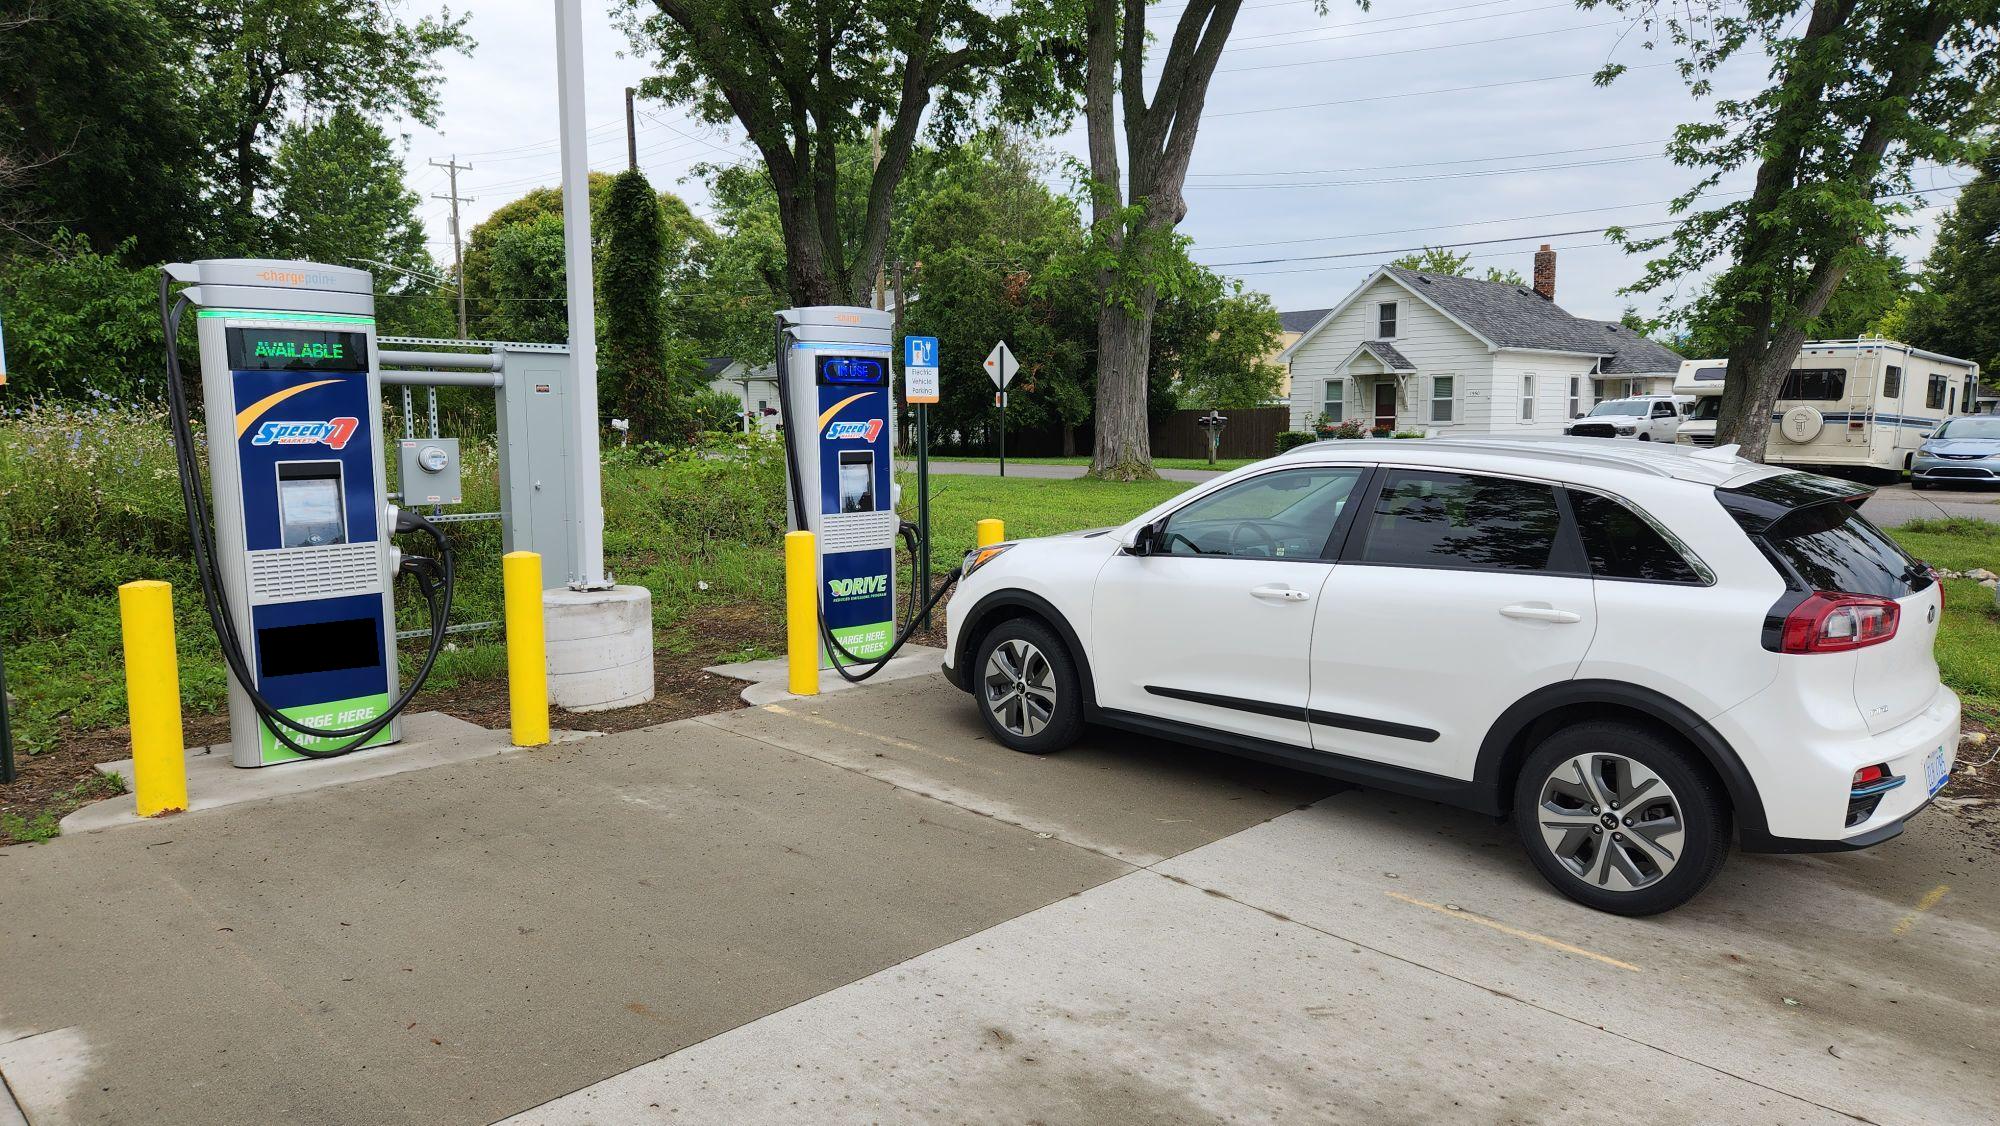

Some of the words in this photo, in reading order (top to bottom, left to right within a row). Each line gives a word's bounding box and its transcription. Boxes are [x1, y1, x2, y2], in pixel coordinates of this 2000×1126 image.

[255, 341, 343, 359] AVAILABLE
[837, 365, 848, 377] IN
[849, 365, 868, 377] USE
[912, 377, 932, 385] Vehicle
[912, 387, 933, 396] Parking
[839, 575, 887, 596] DRIVE
[836, 633, 864, 645] HARGE
[336, 706, 377, 725] HERE.
[1602, 815, 1616, 828] KIA
